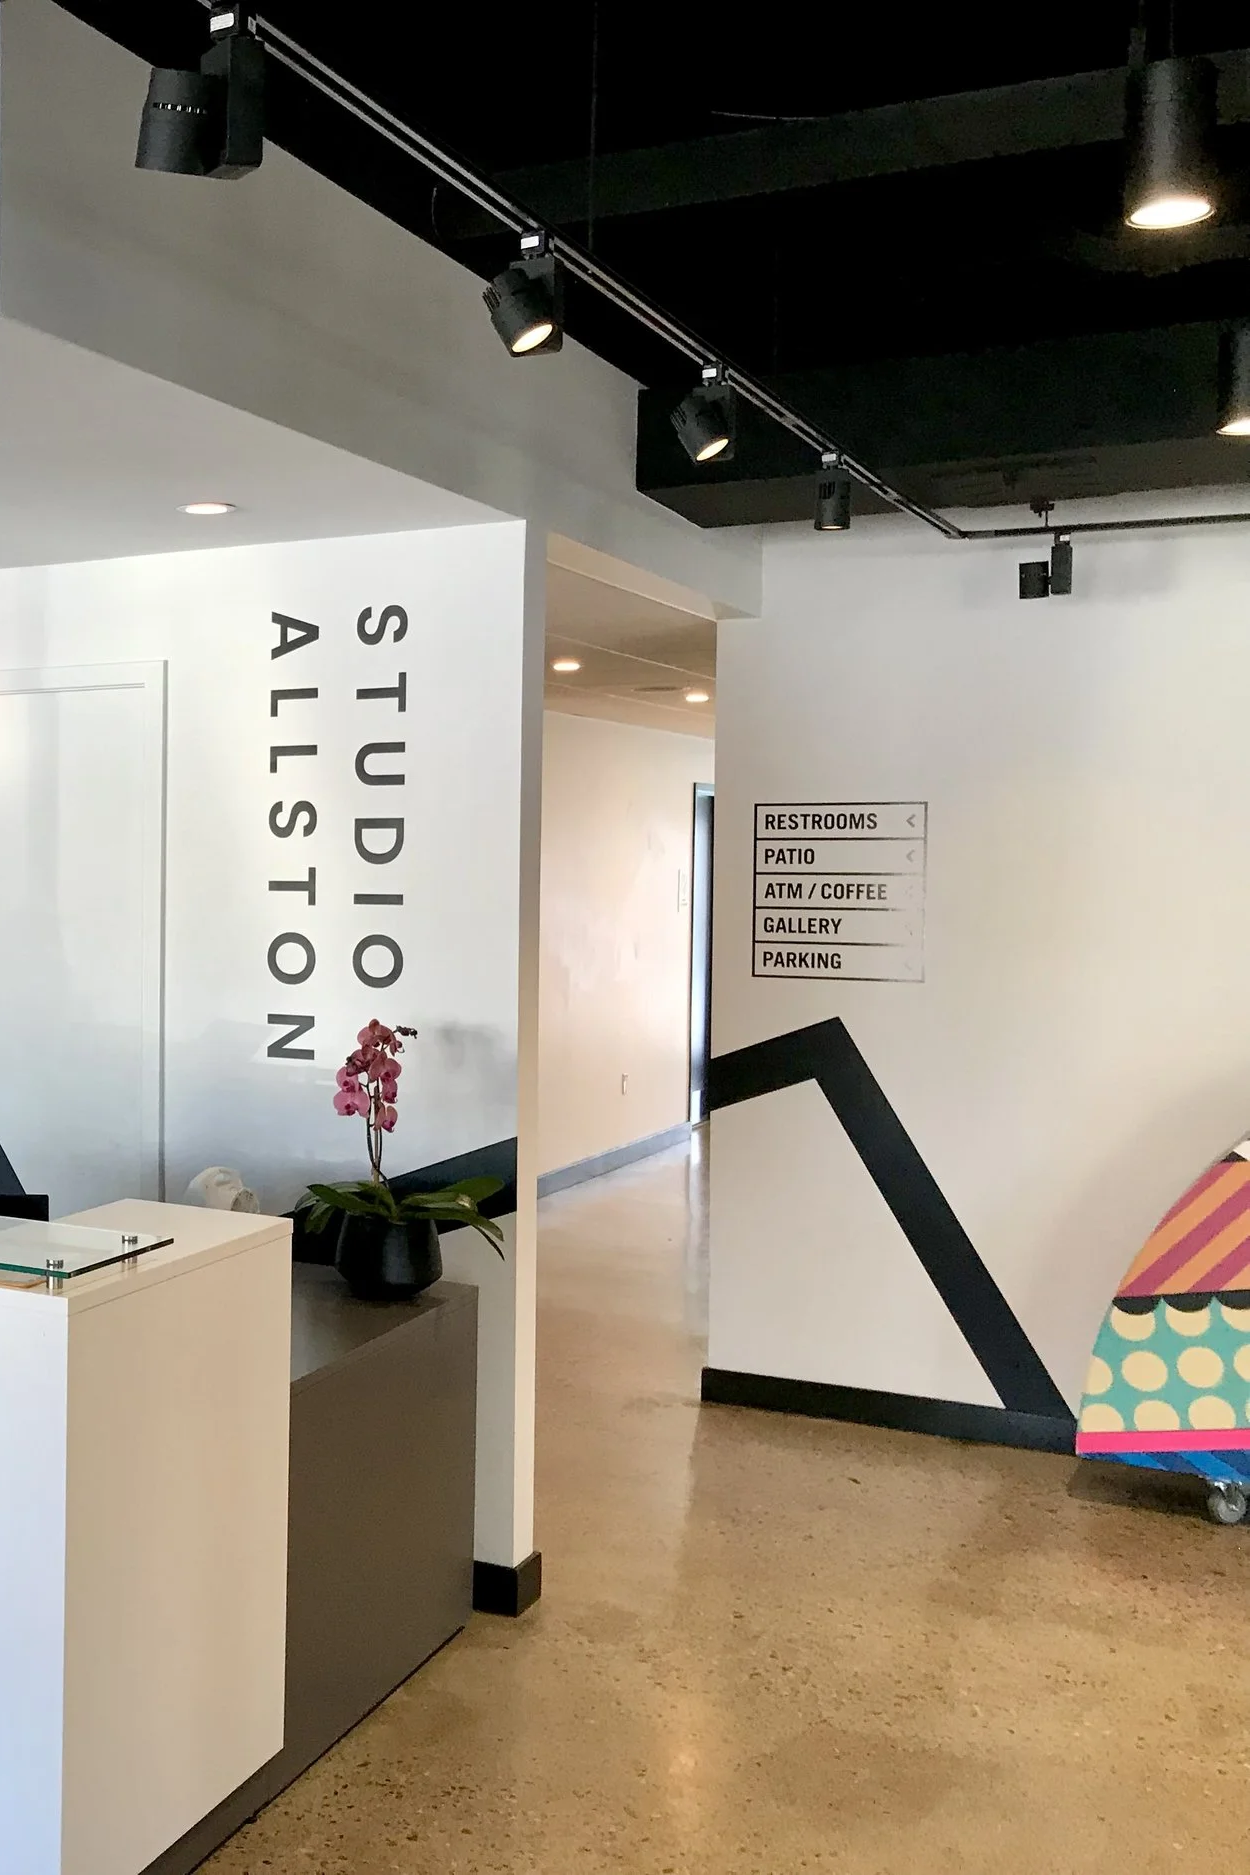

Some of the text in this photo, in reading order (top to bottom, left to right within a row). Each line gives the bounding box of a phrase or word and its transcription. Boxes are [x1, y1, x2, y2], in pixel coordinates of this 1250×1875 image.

[352, 604, 409, 988] STUDIO
[764, 813, 878, 830] RESTROOMS
[267, 611, 320, 1060] ALLSTON
[764, 848, 815, 865] PATIO
[764, 883, 887, 900] ATM / COFFEE
[763, 917, 842, 934] GALLERY
[763, 951, 842, 970] PARKING
